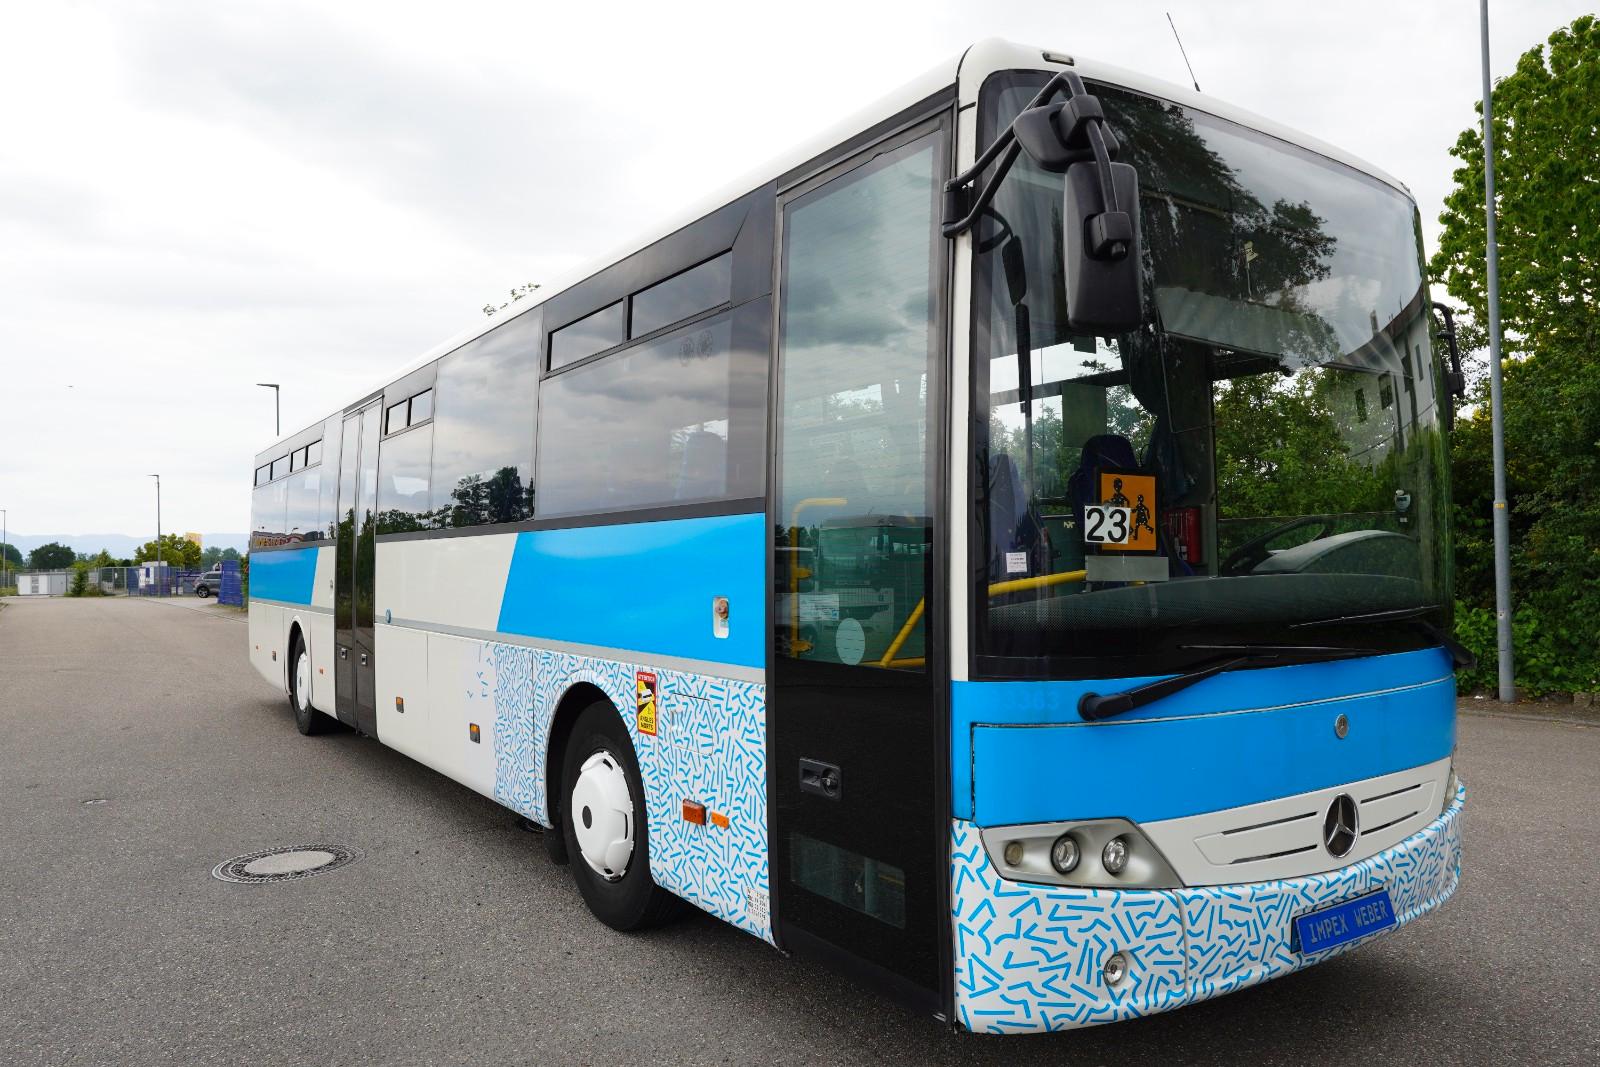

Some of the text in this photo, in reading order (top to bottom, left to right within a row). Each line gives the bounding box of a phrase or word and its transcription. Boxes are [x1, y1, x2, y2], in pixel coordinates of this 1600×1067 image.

[1086, 507, 1127, 542] 23
[1308, 900, 1389, 943] IMPEX WEBER
